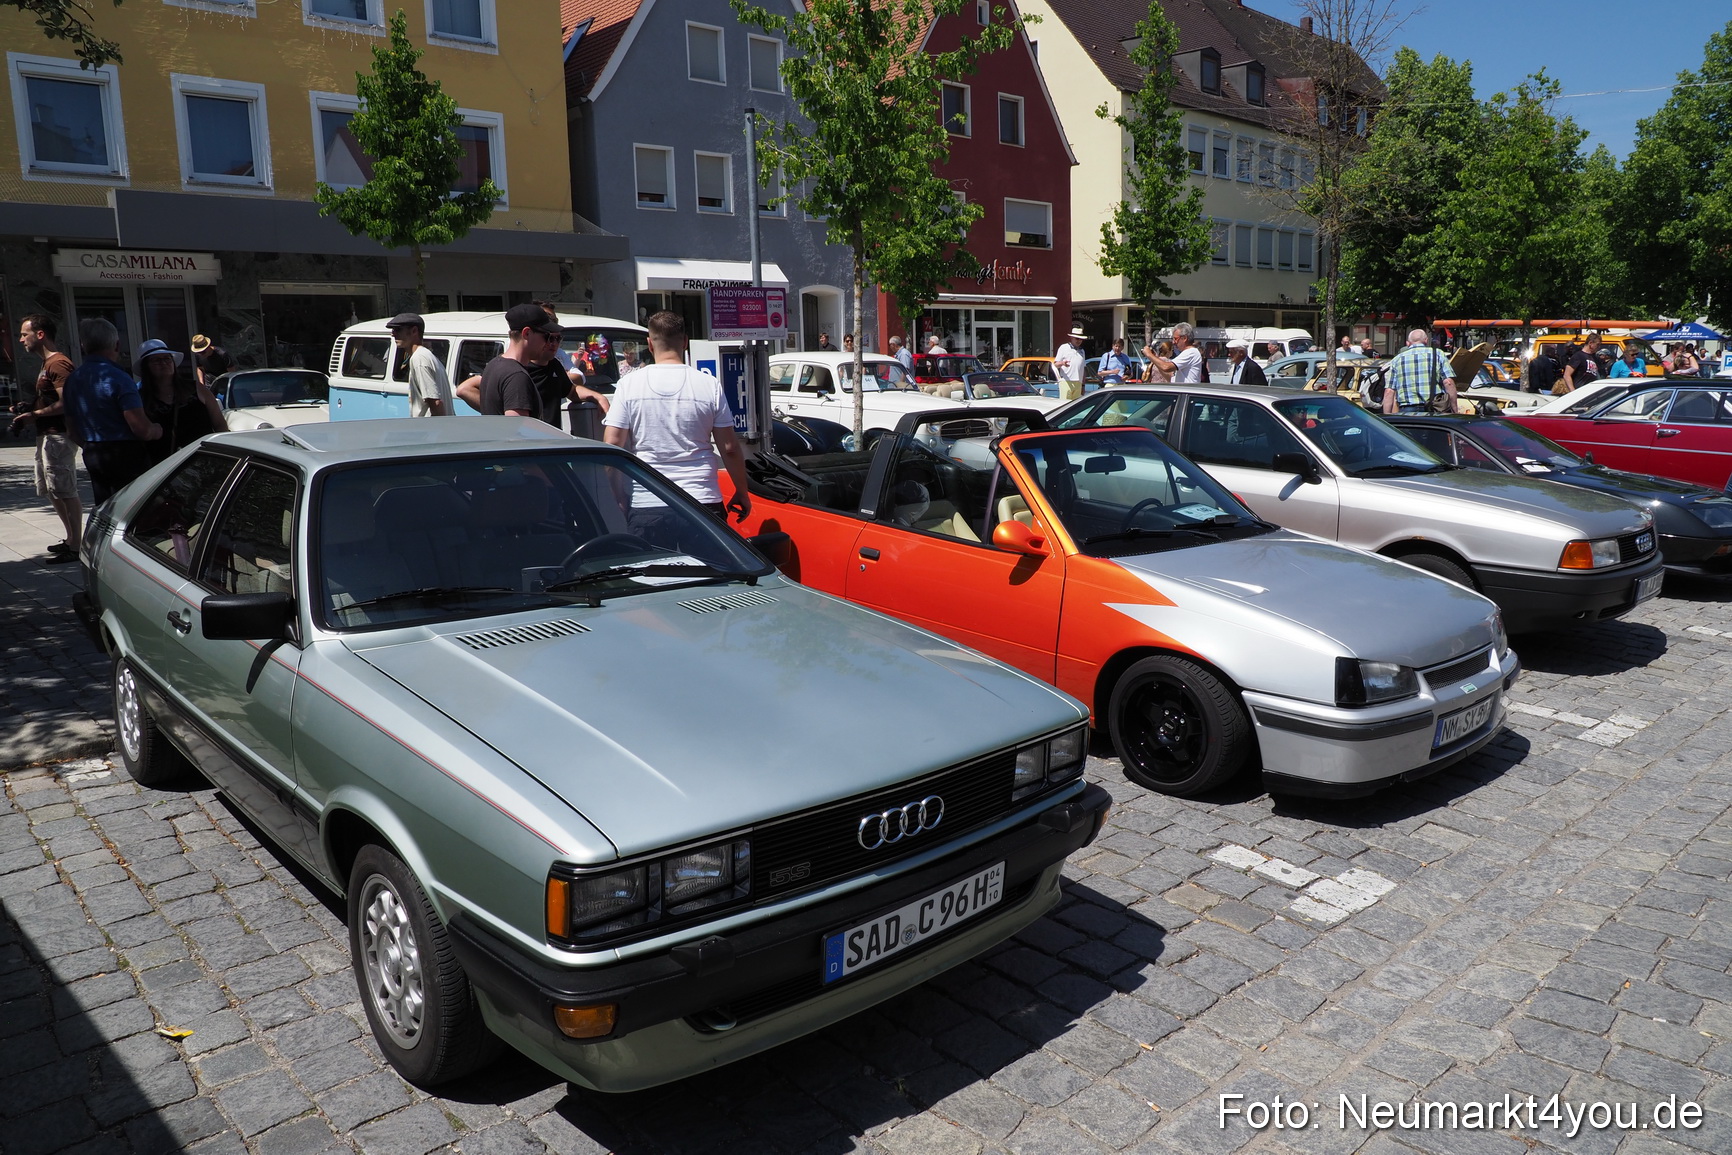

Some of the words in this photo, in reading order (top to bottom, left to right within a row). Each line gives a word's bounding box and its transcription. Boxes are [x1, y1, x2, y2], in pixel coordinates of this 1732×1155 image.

[80, 253, 197, 270] CASAMILANA
[100, 271, 146, 280] Accessoires
[153, 272, 183, 280] Fashion
[713, 289, 764, 298] HANDYPARKEN
[1441, 716, 1459, 741] NM
[988, 867, 1000, 880] 04
[989, 890, 998, 902] 10
[846, 914, 901, 968] SAD
[830, 962, 838, 973] D
